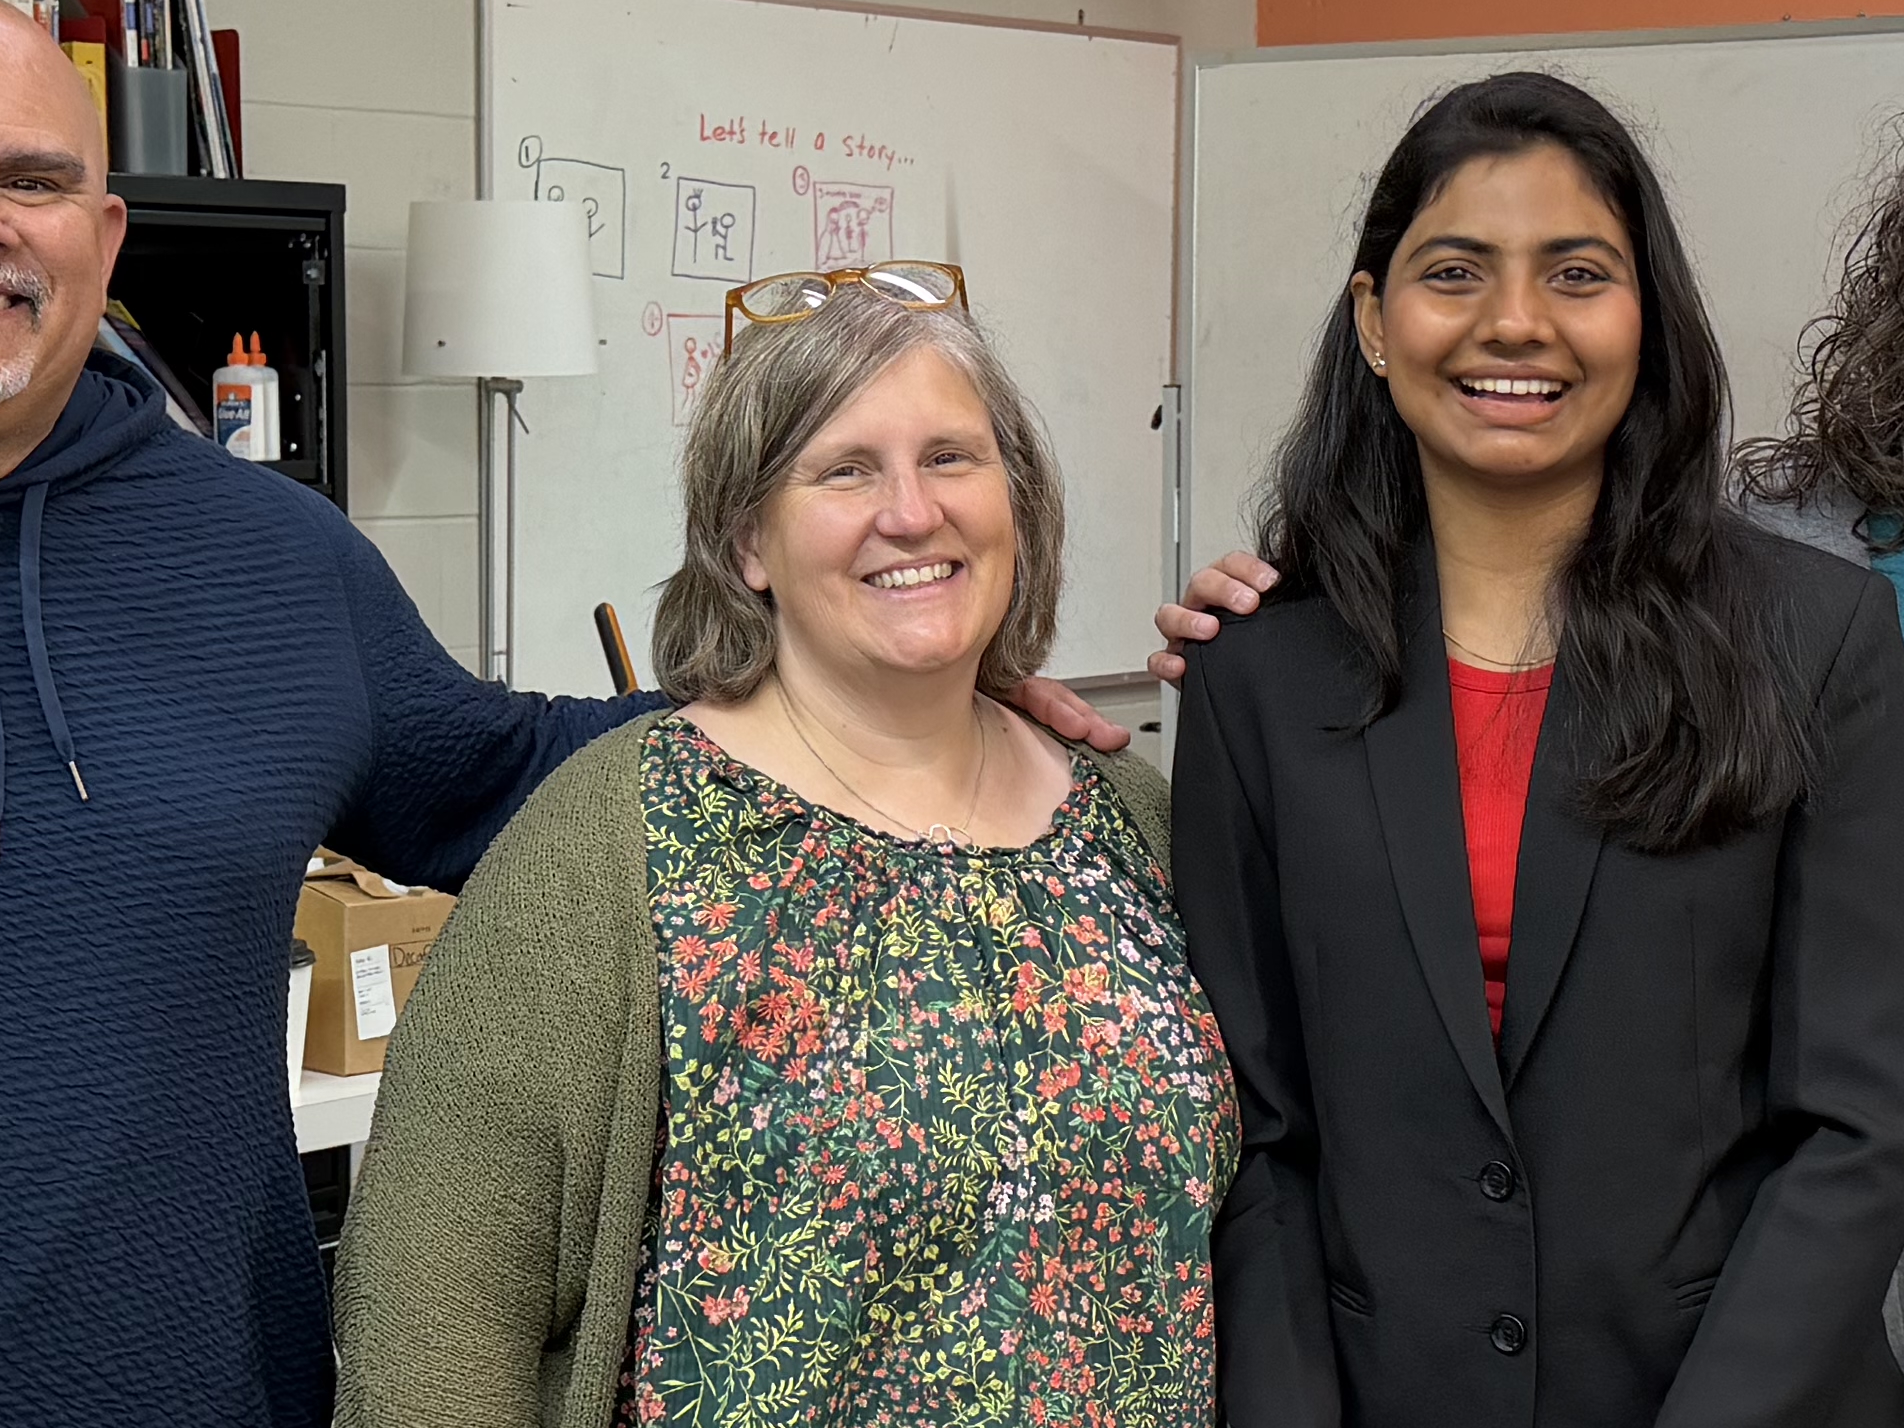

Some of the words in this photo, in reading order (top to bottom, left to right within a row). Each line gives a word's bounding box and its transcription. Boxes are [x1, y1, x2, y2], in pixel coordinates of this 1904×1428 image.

[699, 112, 747, 145] Let's
[758, 118, 796, 150] tell
[813, 130, 826, 152] a
[659, 160, 672, 181] 2
